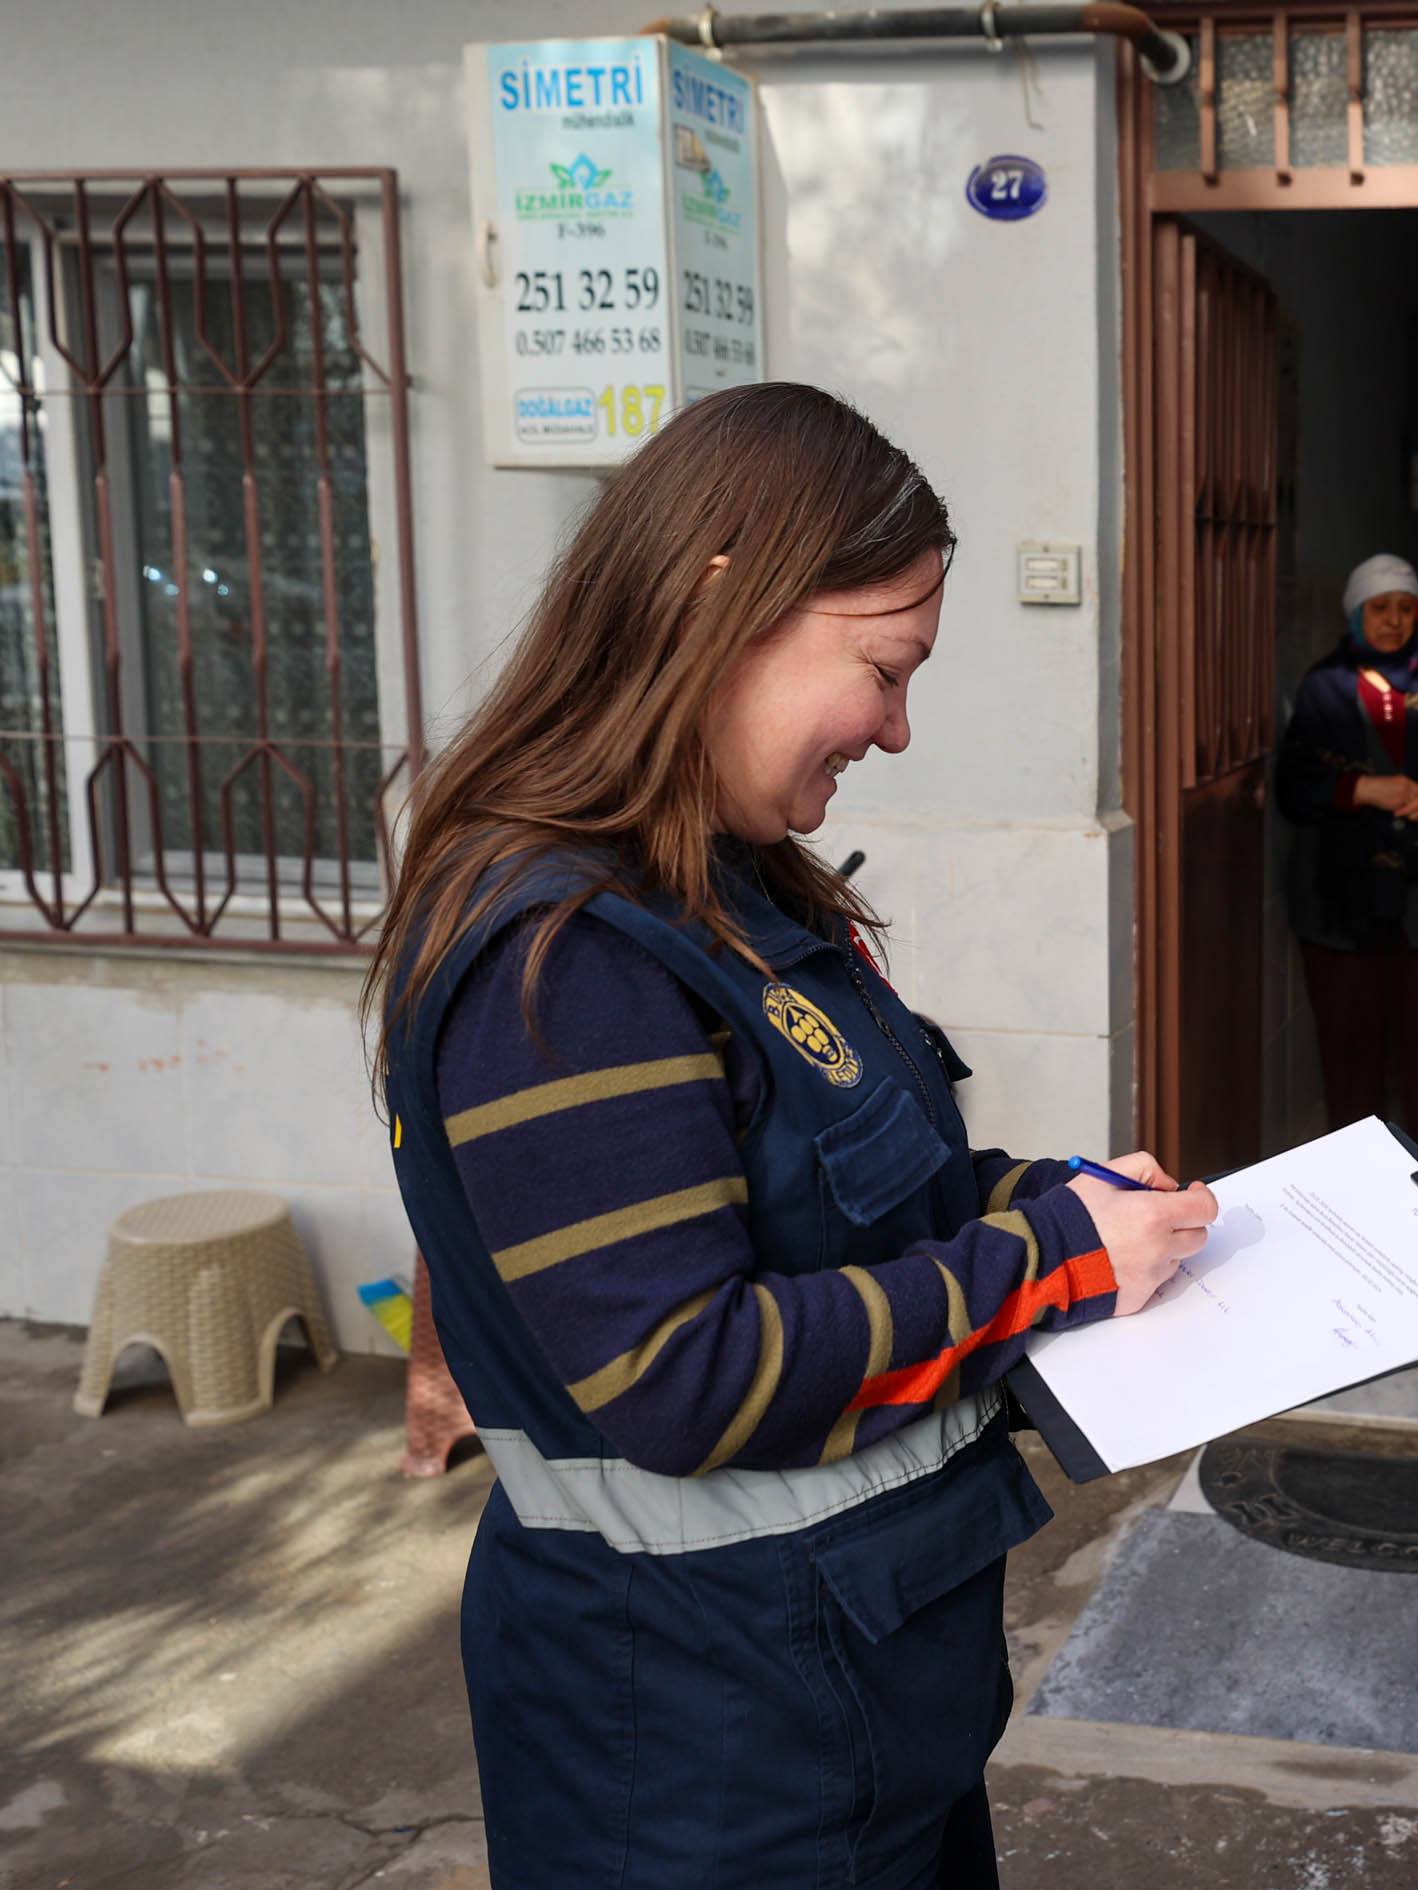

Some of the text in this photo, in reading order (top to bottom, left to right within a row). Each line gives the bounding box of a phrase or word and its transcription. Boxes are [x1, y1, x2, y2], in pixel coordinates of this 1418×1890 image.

[500, 55, 643, 111] SİMETRİ
[991, 168, 1024, 200] 27
[516, 266, 660, 312] 251 32 59
[573, 328, 606, 354] 466
[611, 327, 634, 353] 53
[639, 326, 662, 354] 68
[599, 384, 666, 438] 187
